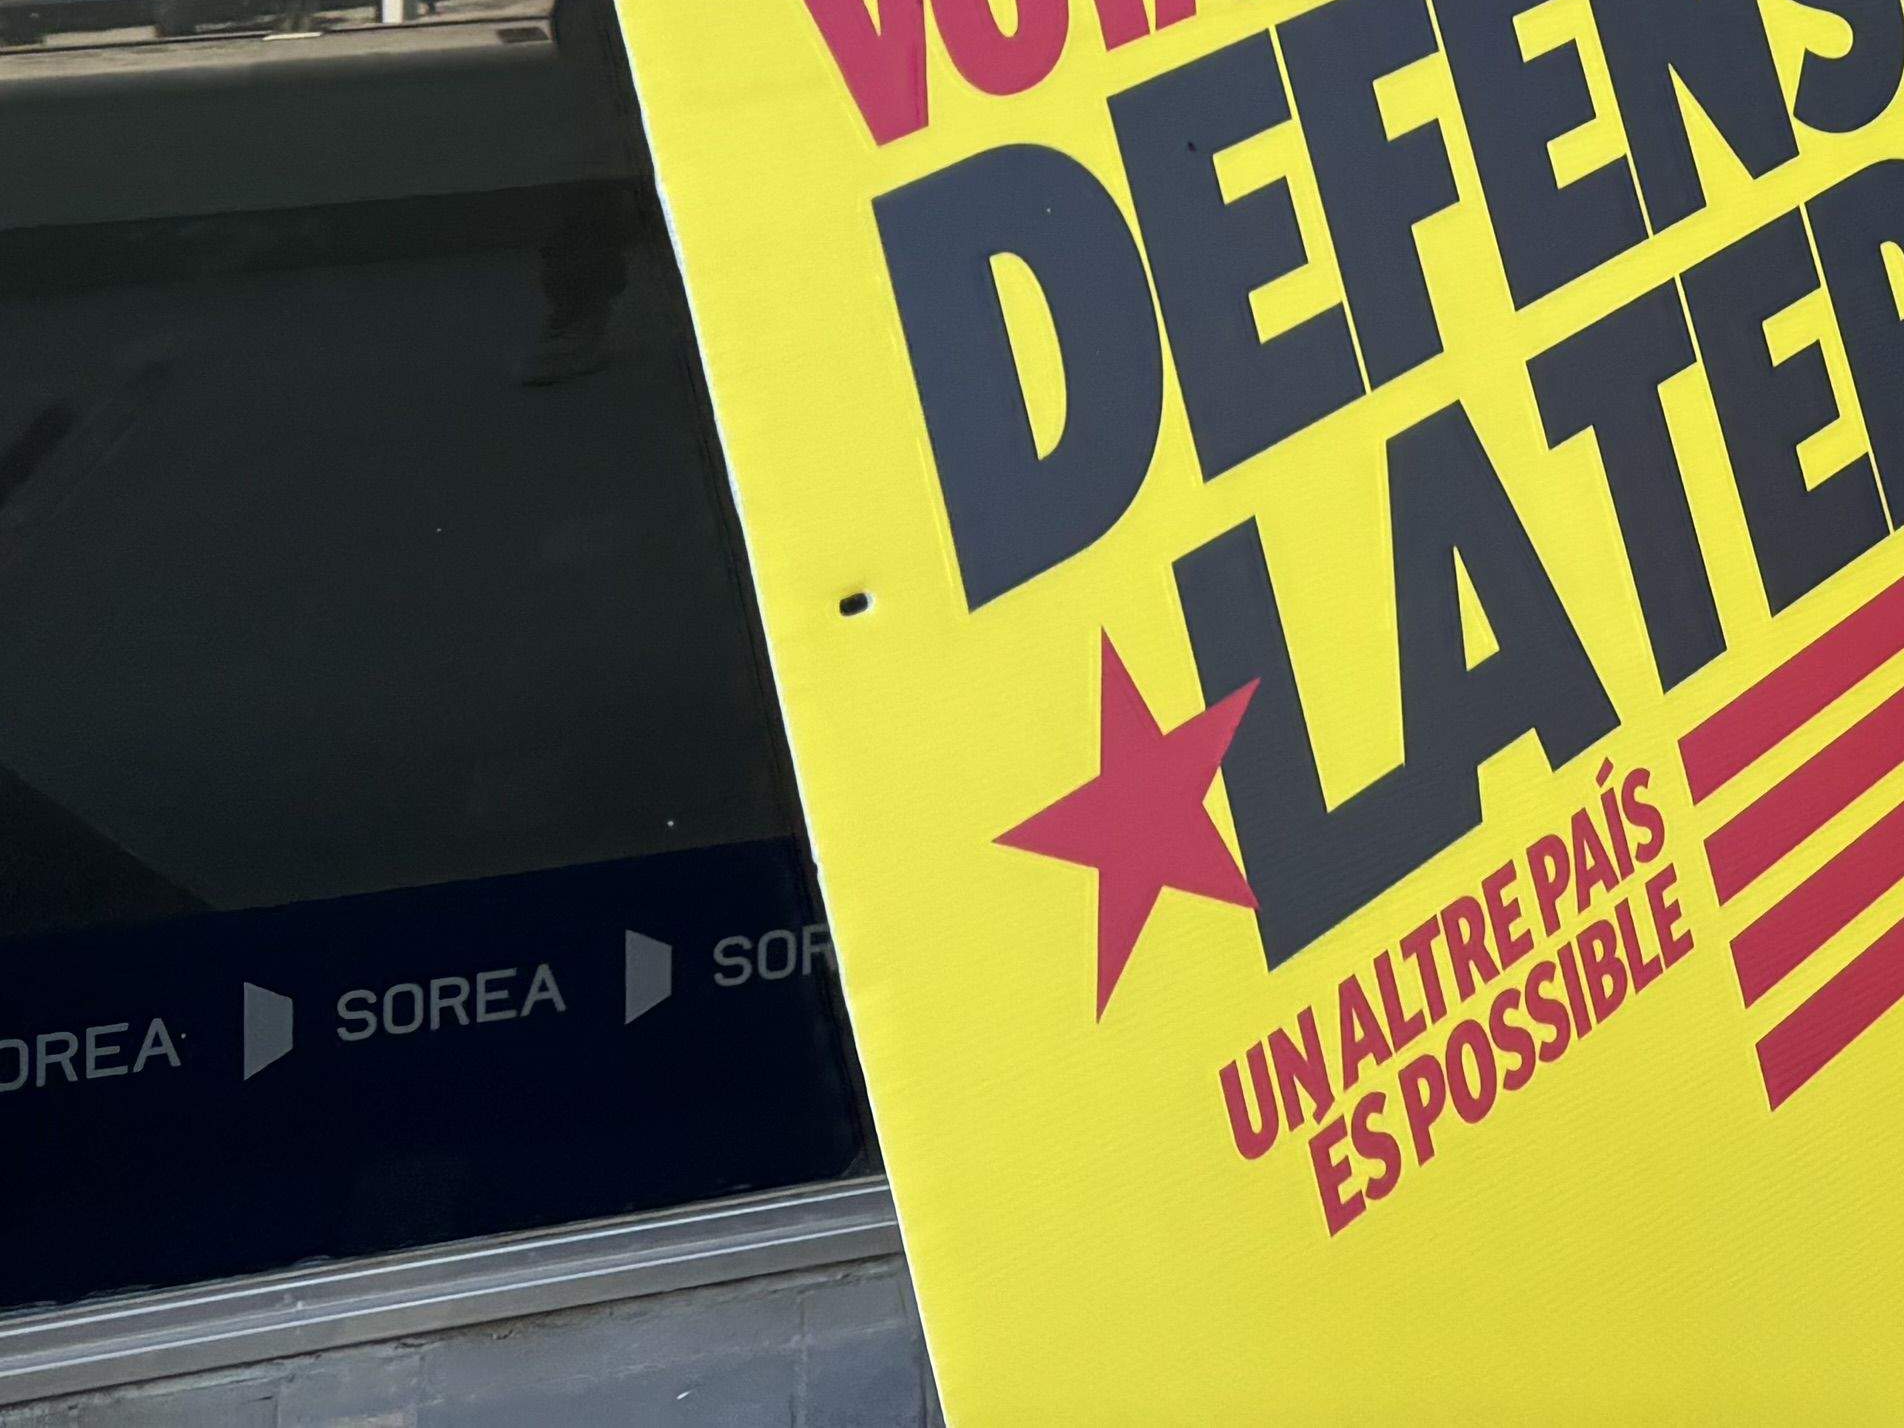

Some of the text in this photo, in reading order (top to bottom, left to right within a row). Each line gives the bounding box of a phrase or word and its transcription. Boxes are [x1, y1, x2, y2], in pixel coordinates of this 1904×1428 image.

[1172, 400, 1620, 973] LA
[336, 964, 566, 1043] SOREA
[1219, 757, 1665, 1160] UN ALTRE PAÍS
[1308, 863, 1695, 1238] ES POSSIBLE
